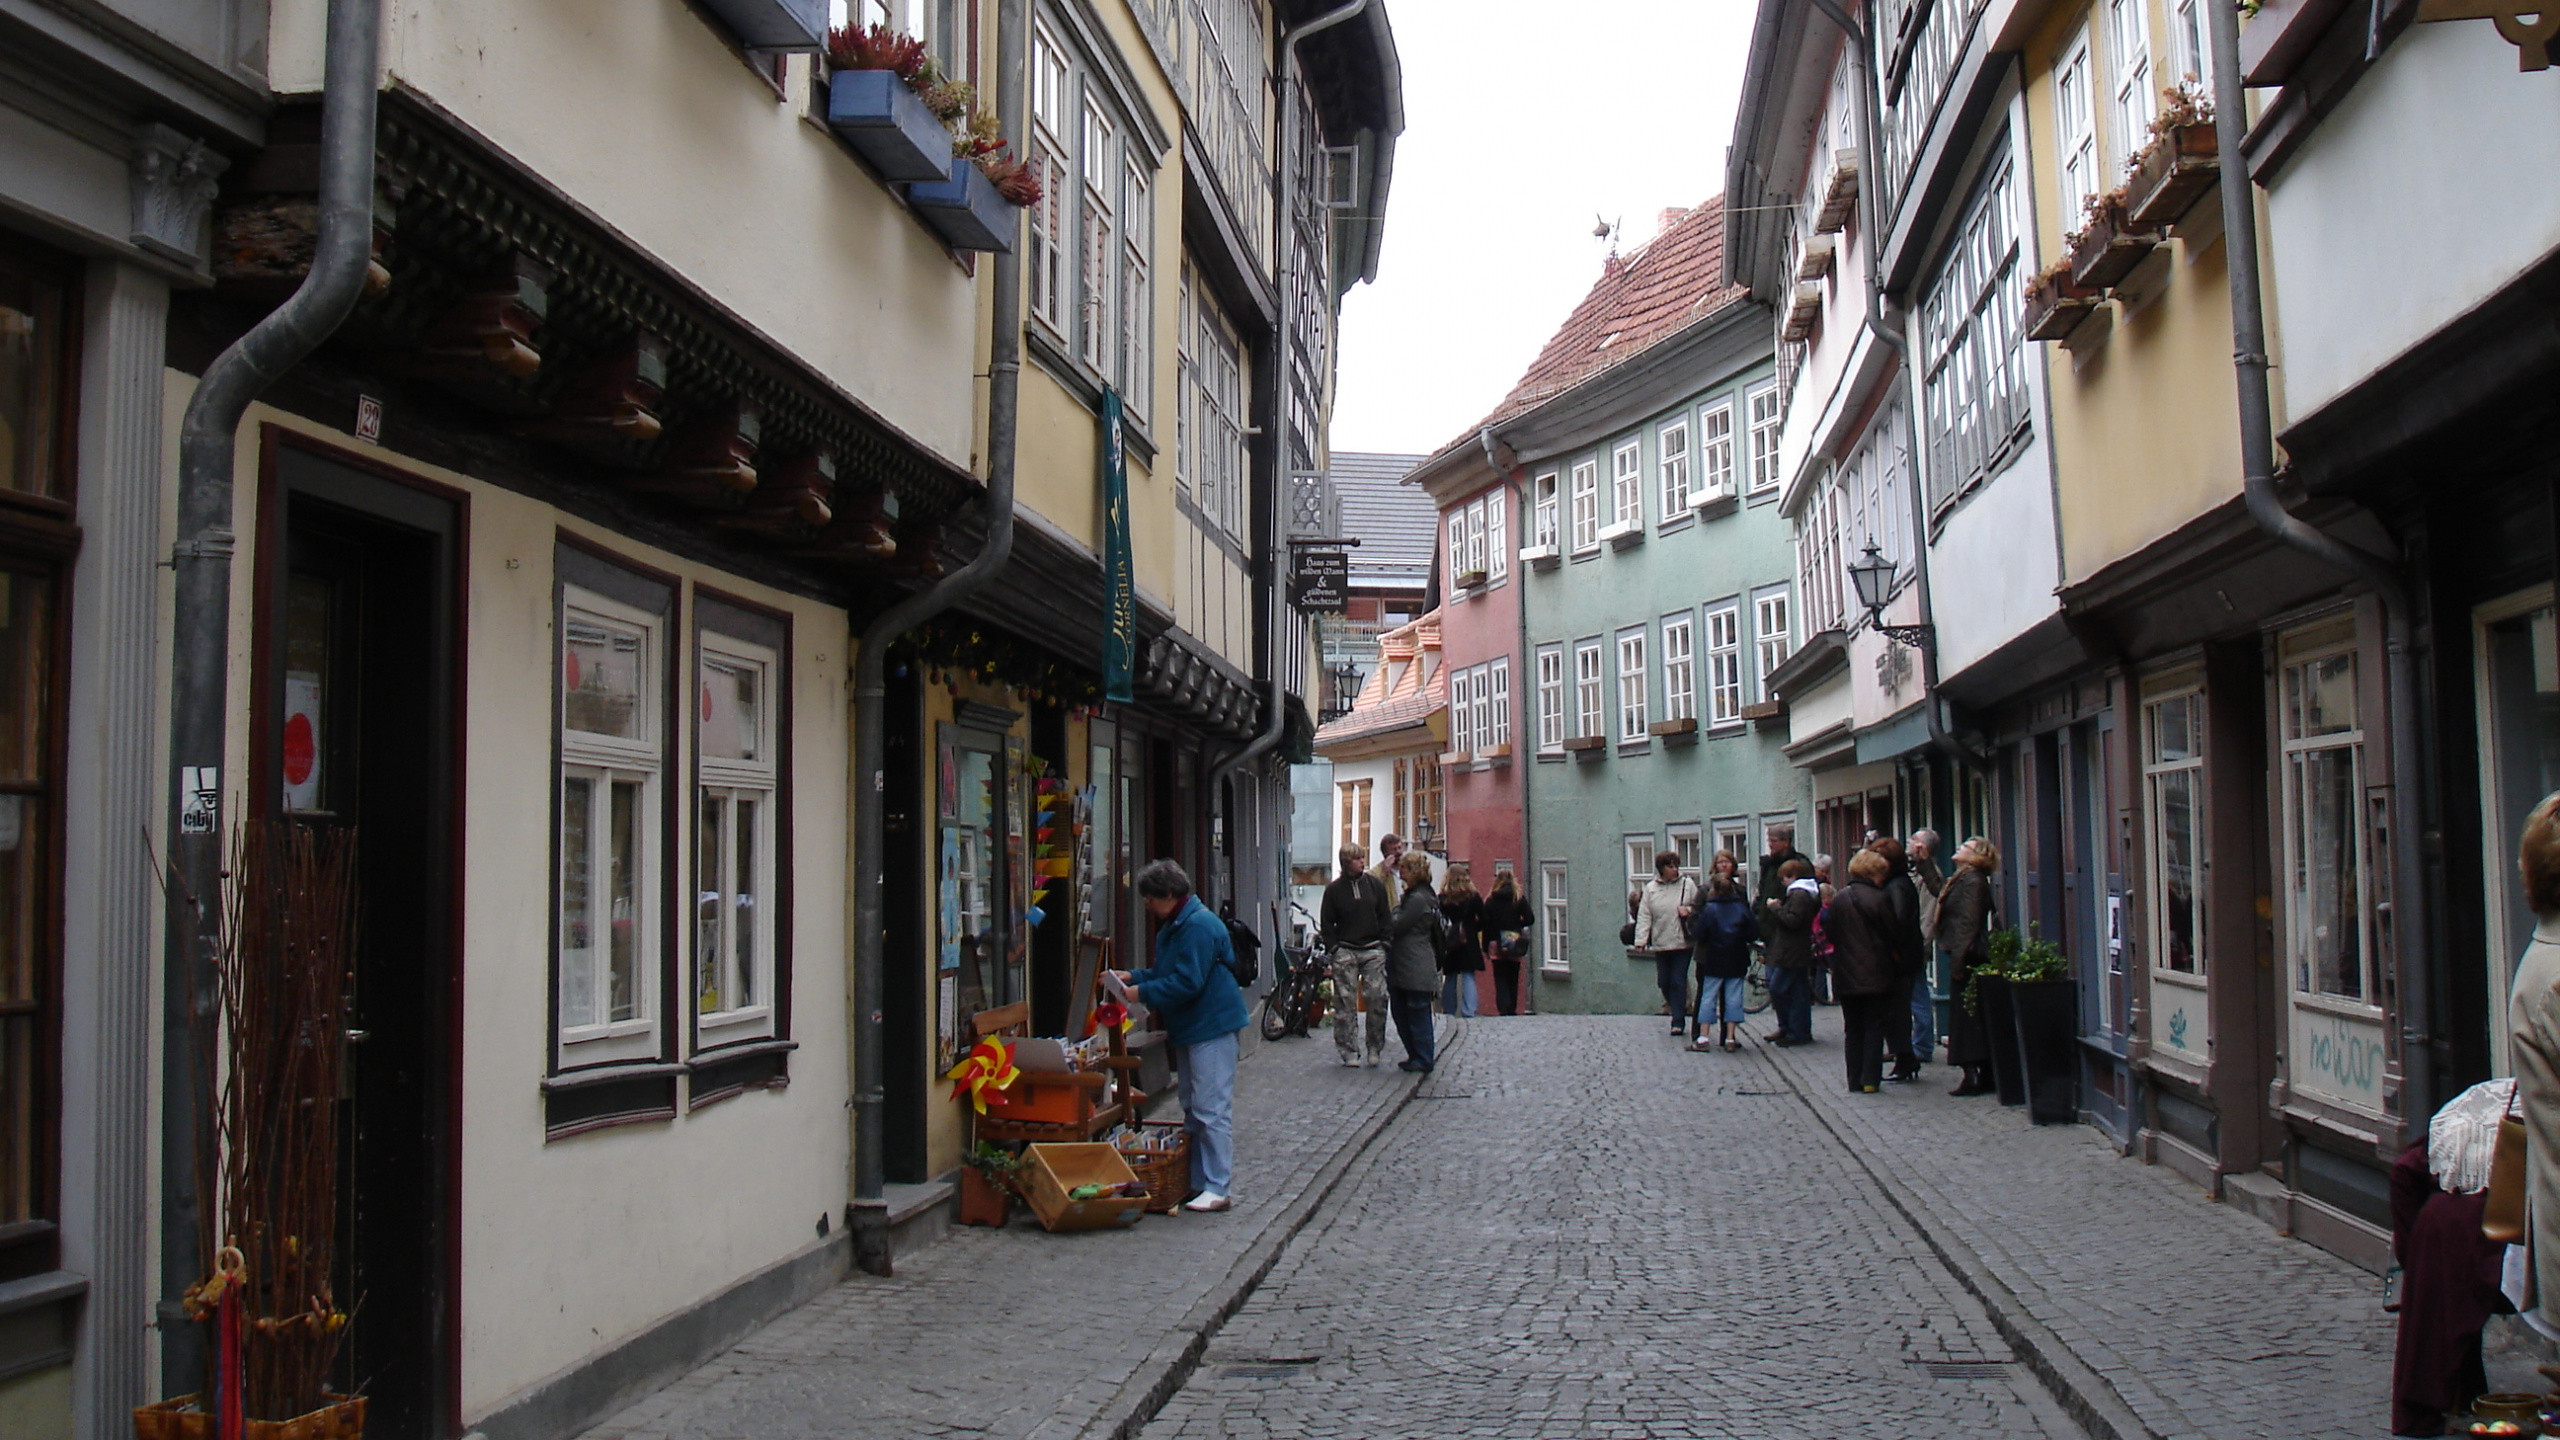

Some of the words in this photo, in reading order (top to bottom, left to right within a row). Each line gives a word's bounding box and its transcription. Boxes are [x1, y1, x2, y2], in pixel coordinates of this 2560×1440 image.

[363, 403, 380, 436] 28
[1305, 556, 1325, 567] Haus
[1299, 567, 1322, 575] wilden
[1323, 567, 1345, 575] Mann
[1317, 575, 1327, 588] &
[1117, 559, 1133, 645] CORNELIA
